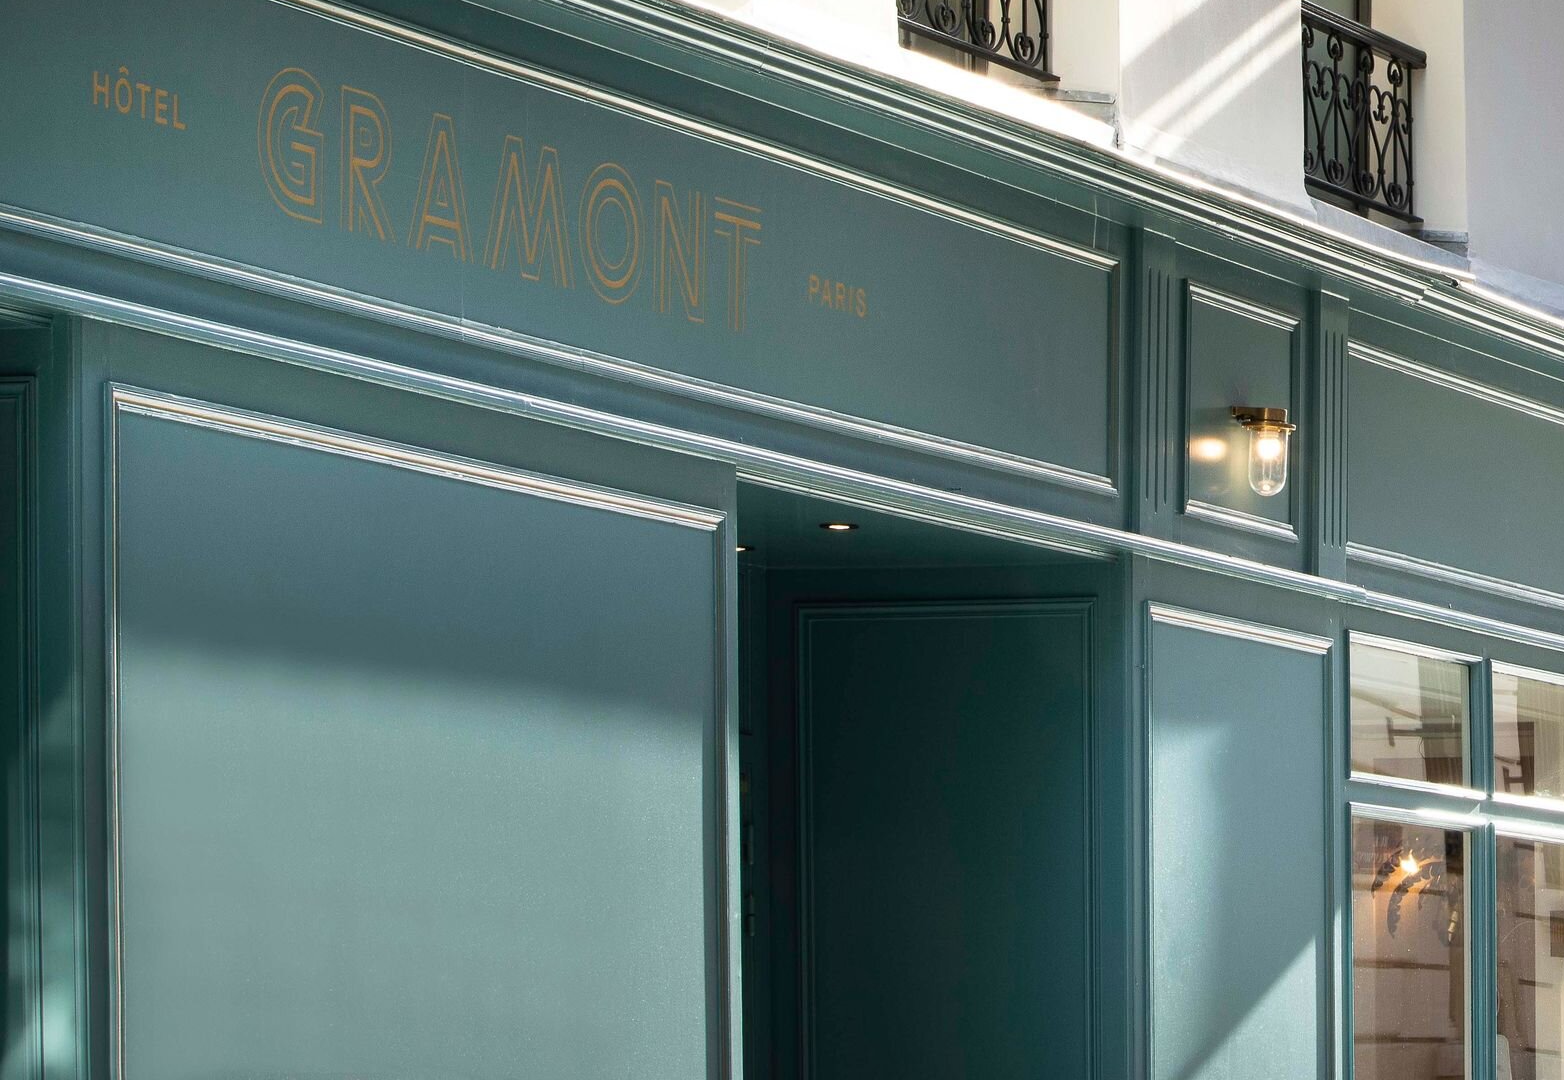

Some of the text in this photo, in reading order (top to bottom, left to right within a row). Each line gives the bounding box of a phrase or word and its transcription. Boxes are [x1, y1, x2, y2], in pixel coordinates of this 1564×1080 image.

[92, 65, 869, 331] HÔTEL GRAMONT PARIS
